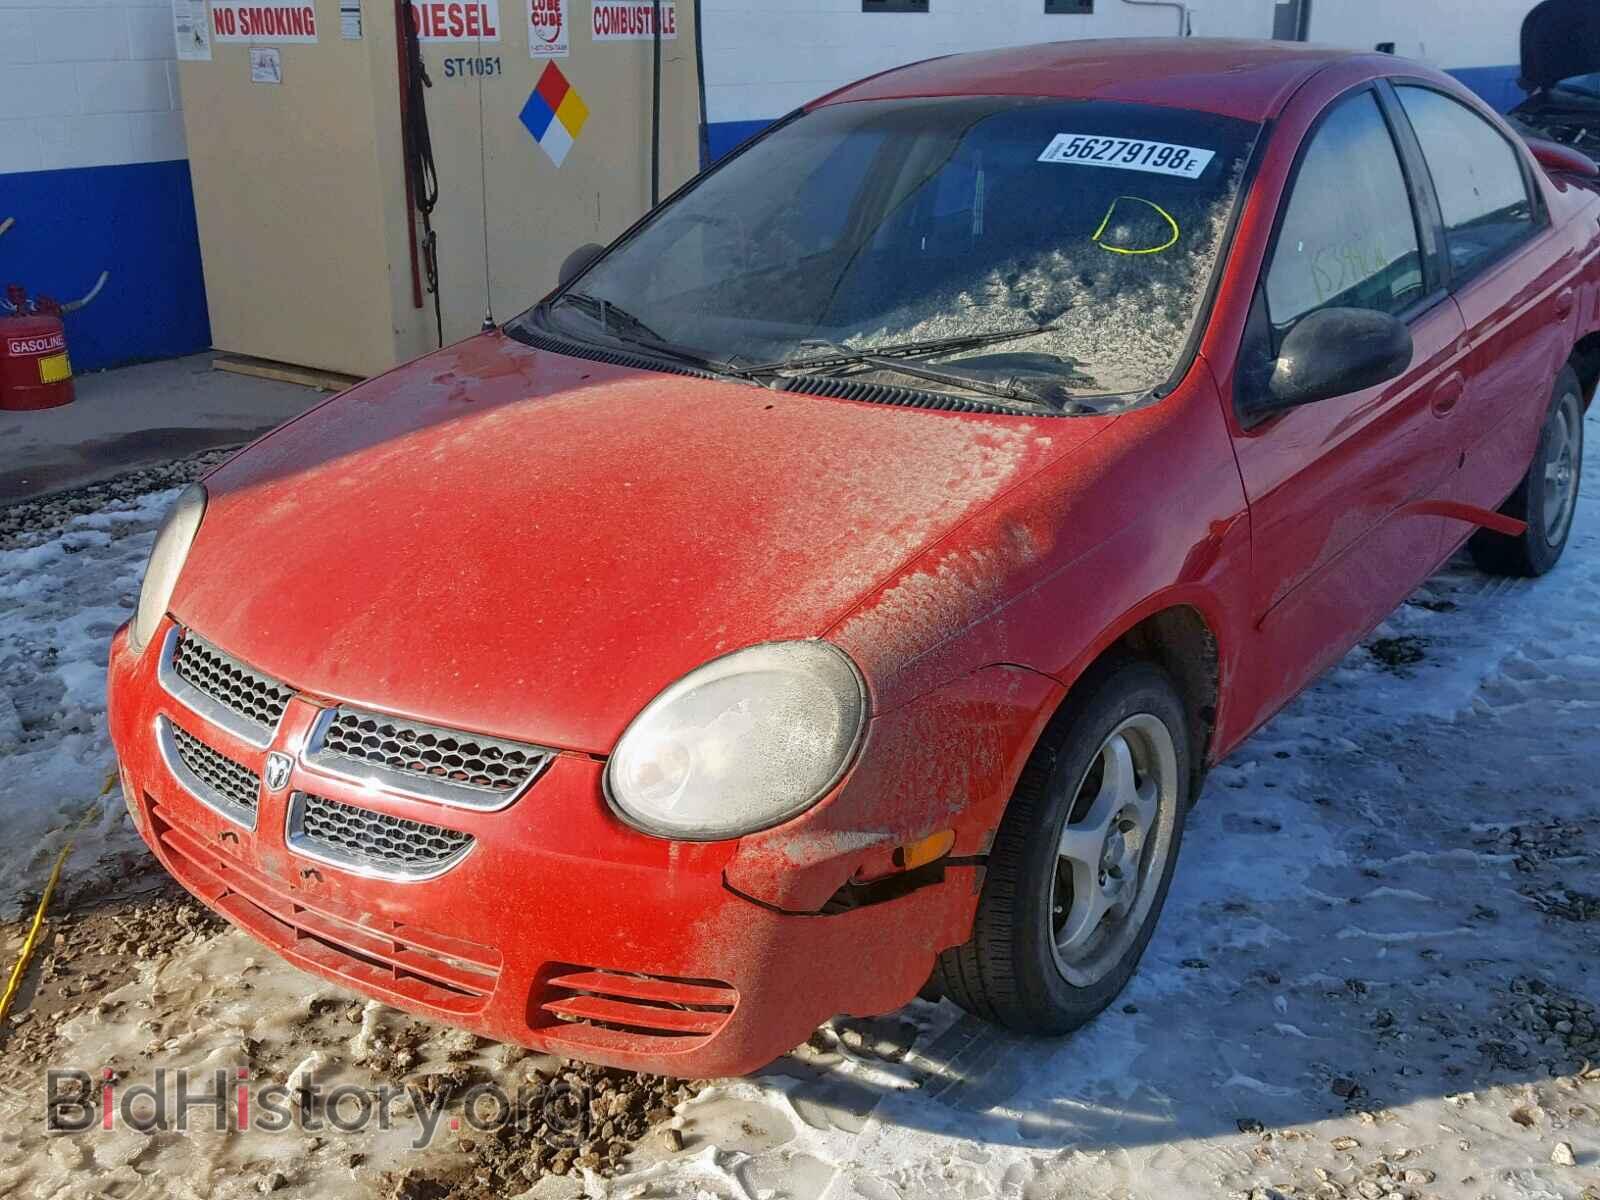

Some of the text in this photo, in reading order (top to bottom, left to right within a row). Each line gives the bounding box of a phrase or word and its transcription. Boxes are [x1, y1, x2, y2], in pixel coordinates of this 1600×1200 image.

[213, 8, 235, 36] NO
[240, 7, 316, 36] SMOKING
[531, 11, 563, 27] CUBE
[593, 6, 675, 35] COMBUSTILE
[444, 57, 502, 78] ST1051
[11, 335, 64, 353] GASOLINE
